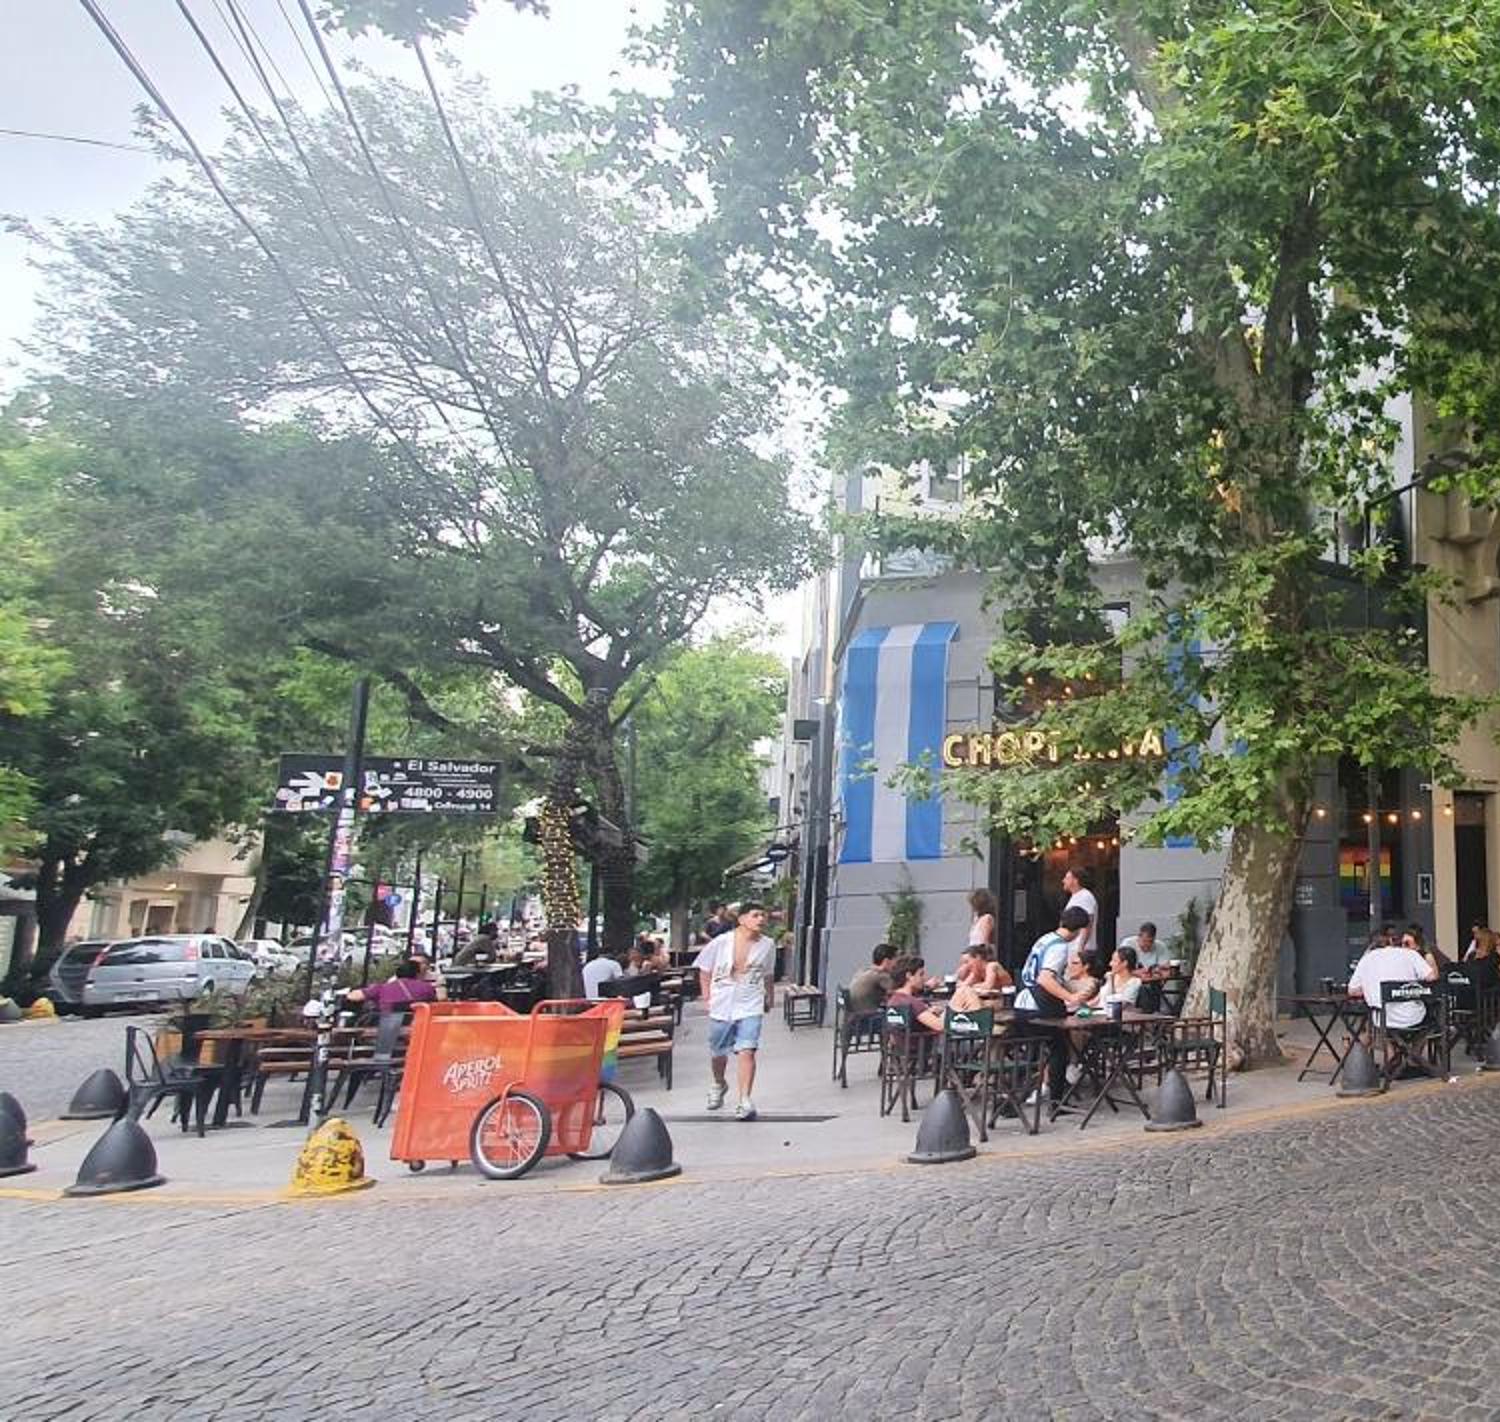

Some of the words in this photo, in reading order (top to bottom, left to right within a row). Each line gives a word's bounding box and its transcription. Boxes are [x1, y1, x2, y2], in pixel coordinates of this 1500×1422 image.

[407, 760, 423, 771] El
[428, 761, 496, 775] Salvador
[404, 787, 442, 799] 4800
[456, 788, 493, 800] 4900
[443, 1056, 503, 1085] APEROL
